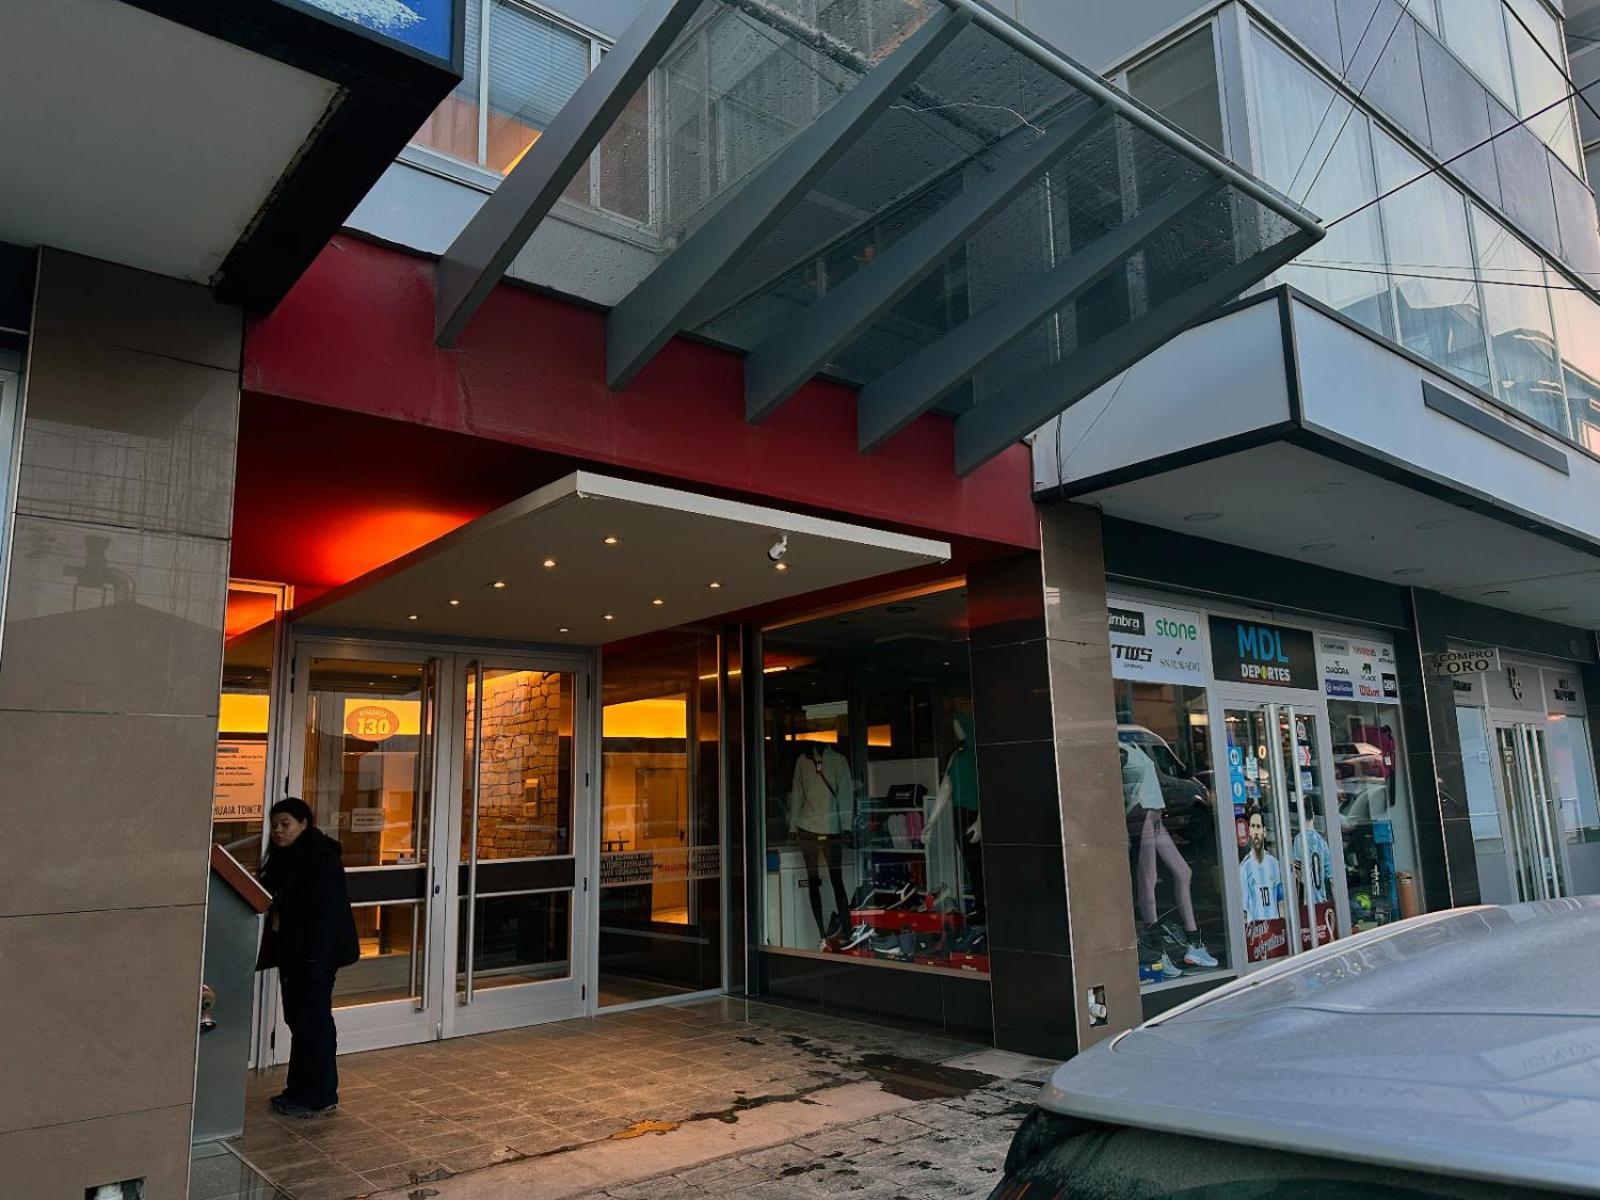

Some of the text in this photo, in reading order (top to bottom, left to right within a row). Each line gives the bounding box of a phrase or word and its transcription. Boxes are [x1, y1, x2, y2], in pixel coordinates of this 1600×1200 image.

[1155, 618, 1197, 640] stone
[1236, 624, 1290, 663] MDL
[1439, 650, 1494, 662] COMPRO
[1240, 663, 1292, 683] DEPORTES
[1447, 659, 1490, 674] ORO
[357, 717, 390, 735] 130
[238, 804, 263, 816] TOWER
[1259, 886, 1270, 906] 10
